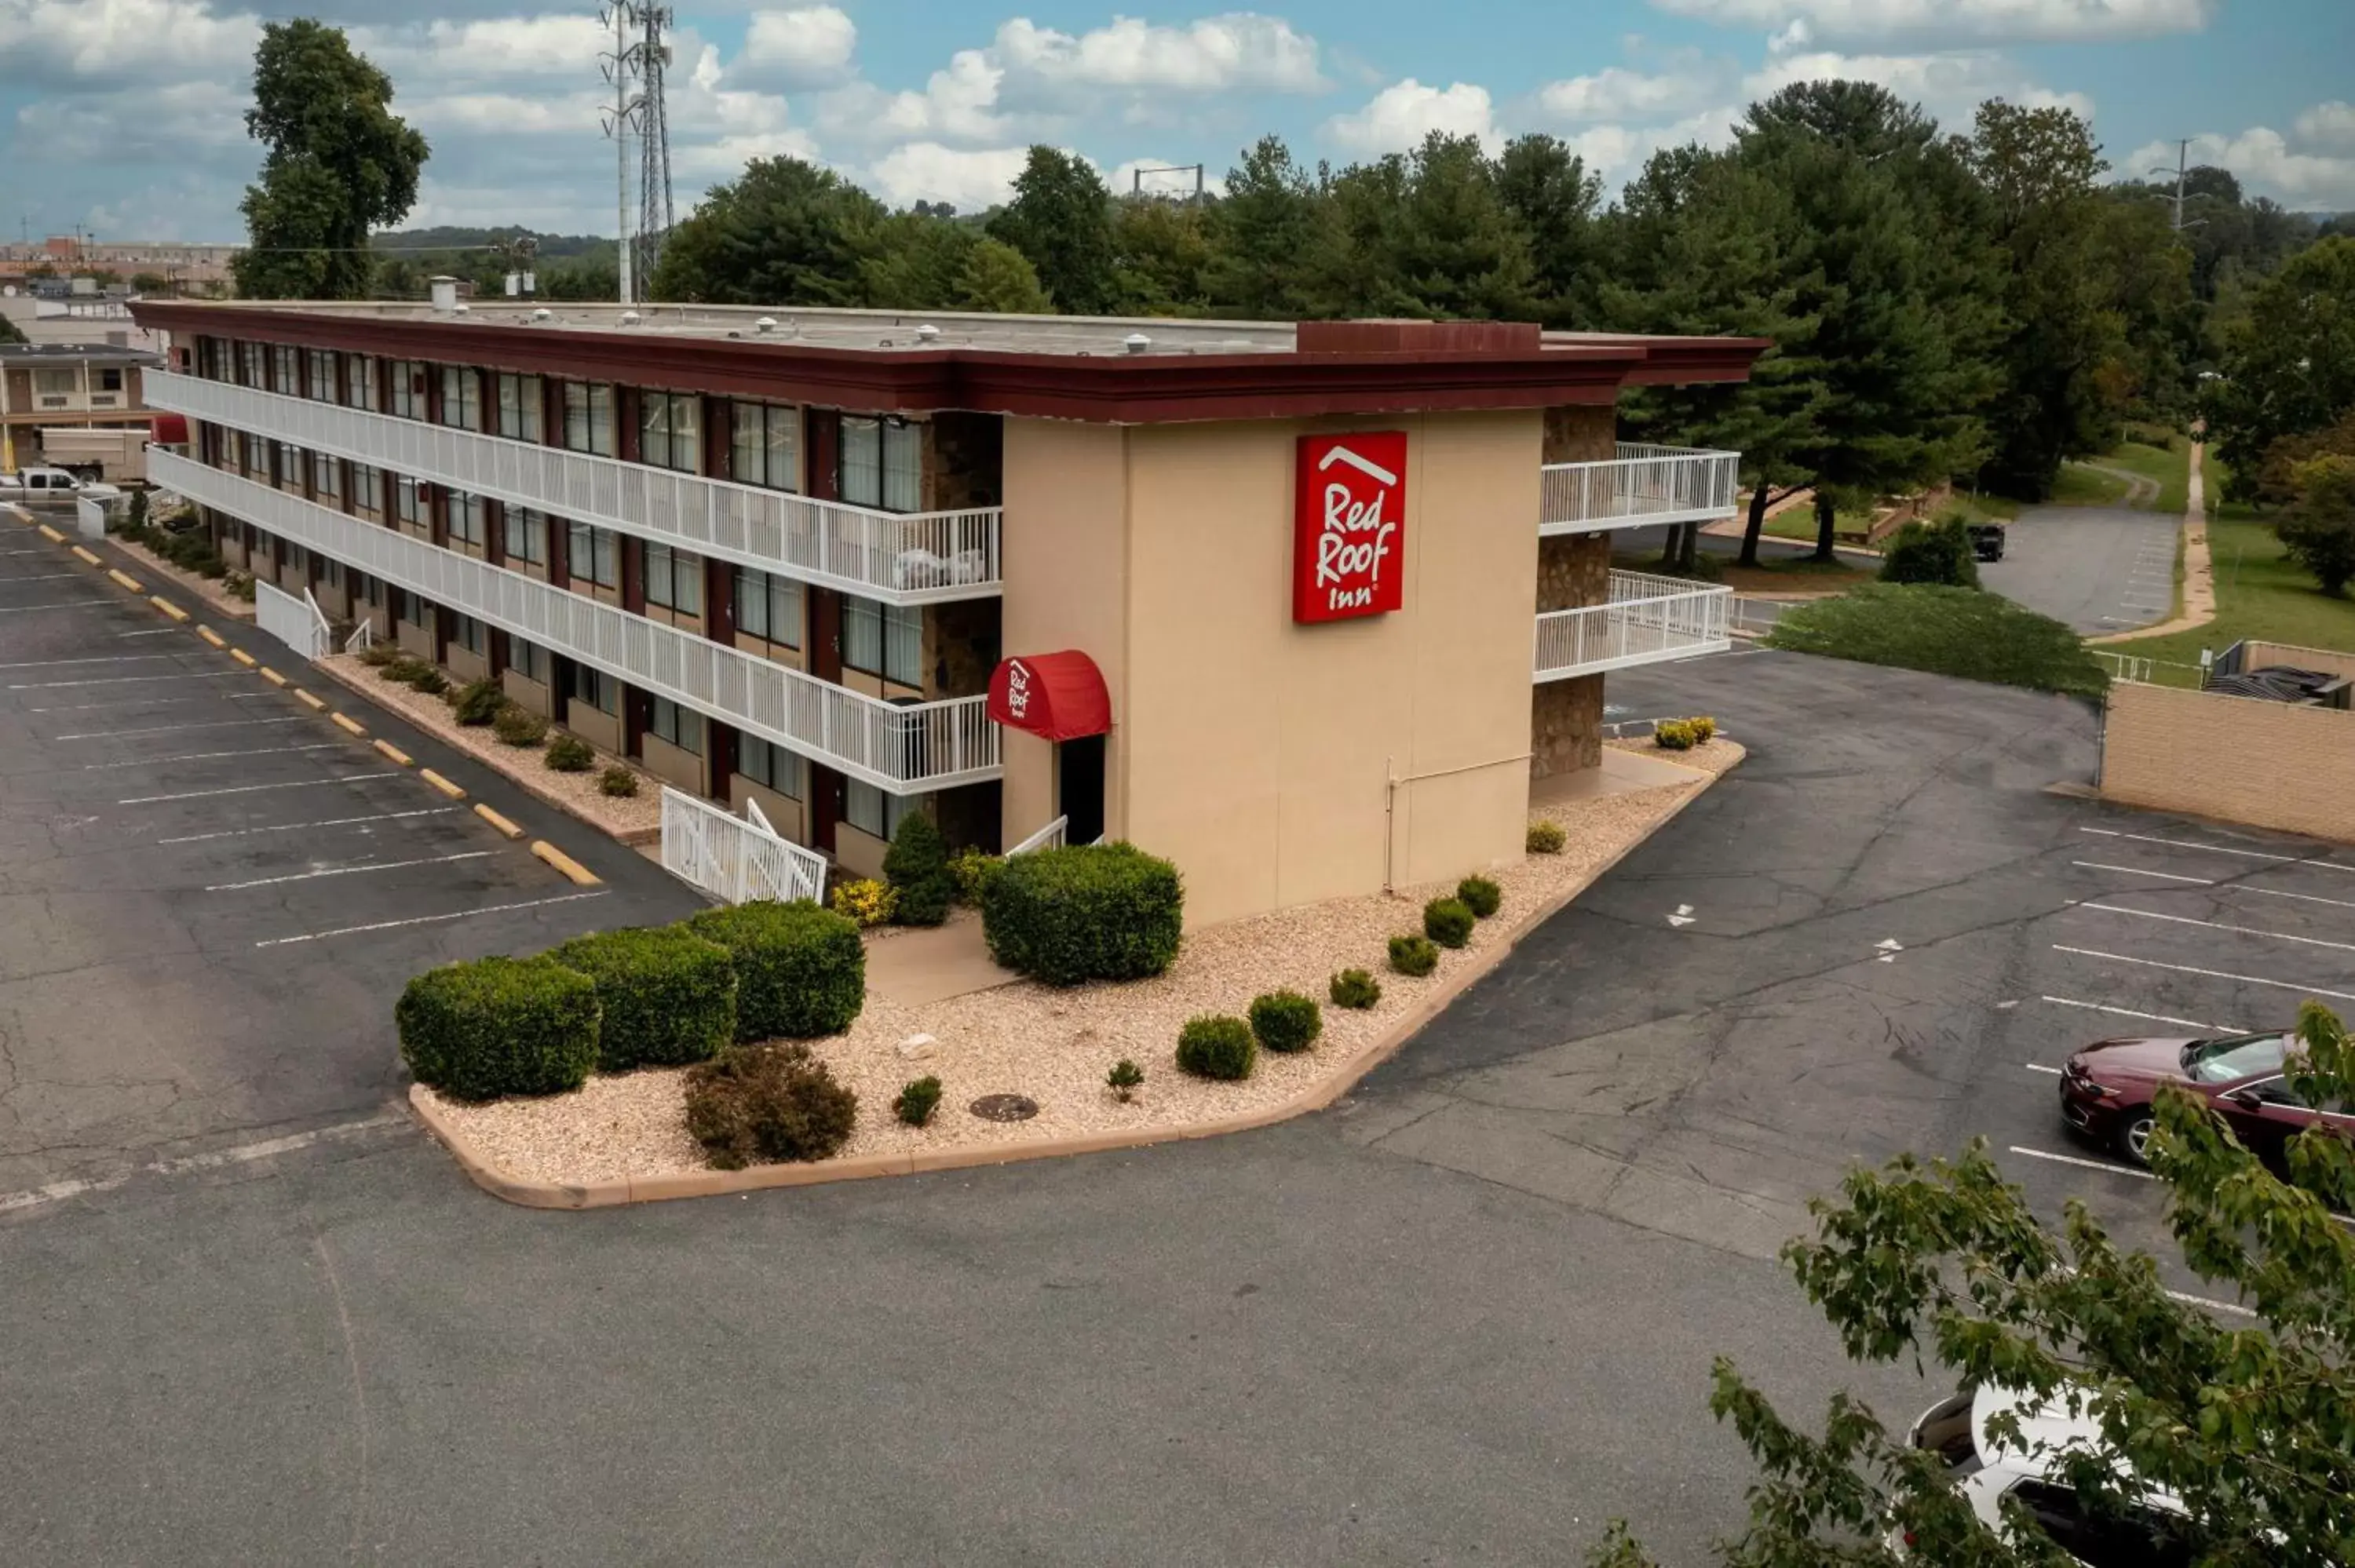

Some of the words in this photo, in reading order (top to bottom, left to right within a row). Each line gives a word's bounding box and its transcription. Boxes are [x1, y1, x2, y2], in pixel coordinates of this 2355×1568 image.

[1325, 483, 1384, 534] Red
[1317, 523, 1396, 587] Roof
[1330, 588, 1371, 610] Inn
[1011, 670, 1026, 690] Red
[1010, 687, 1030, 711] Roof
